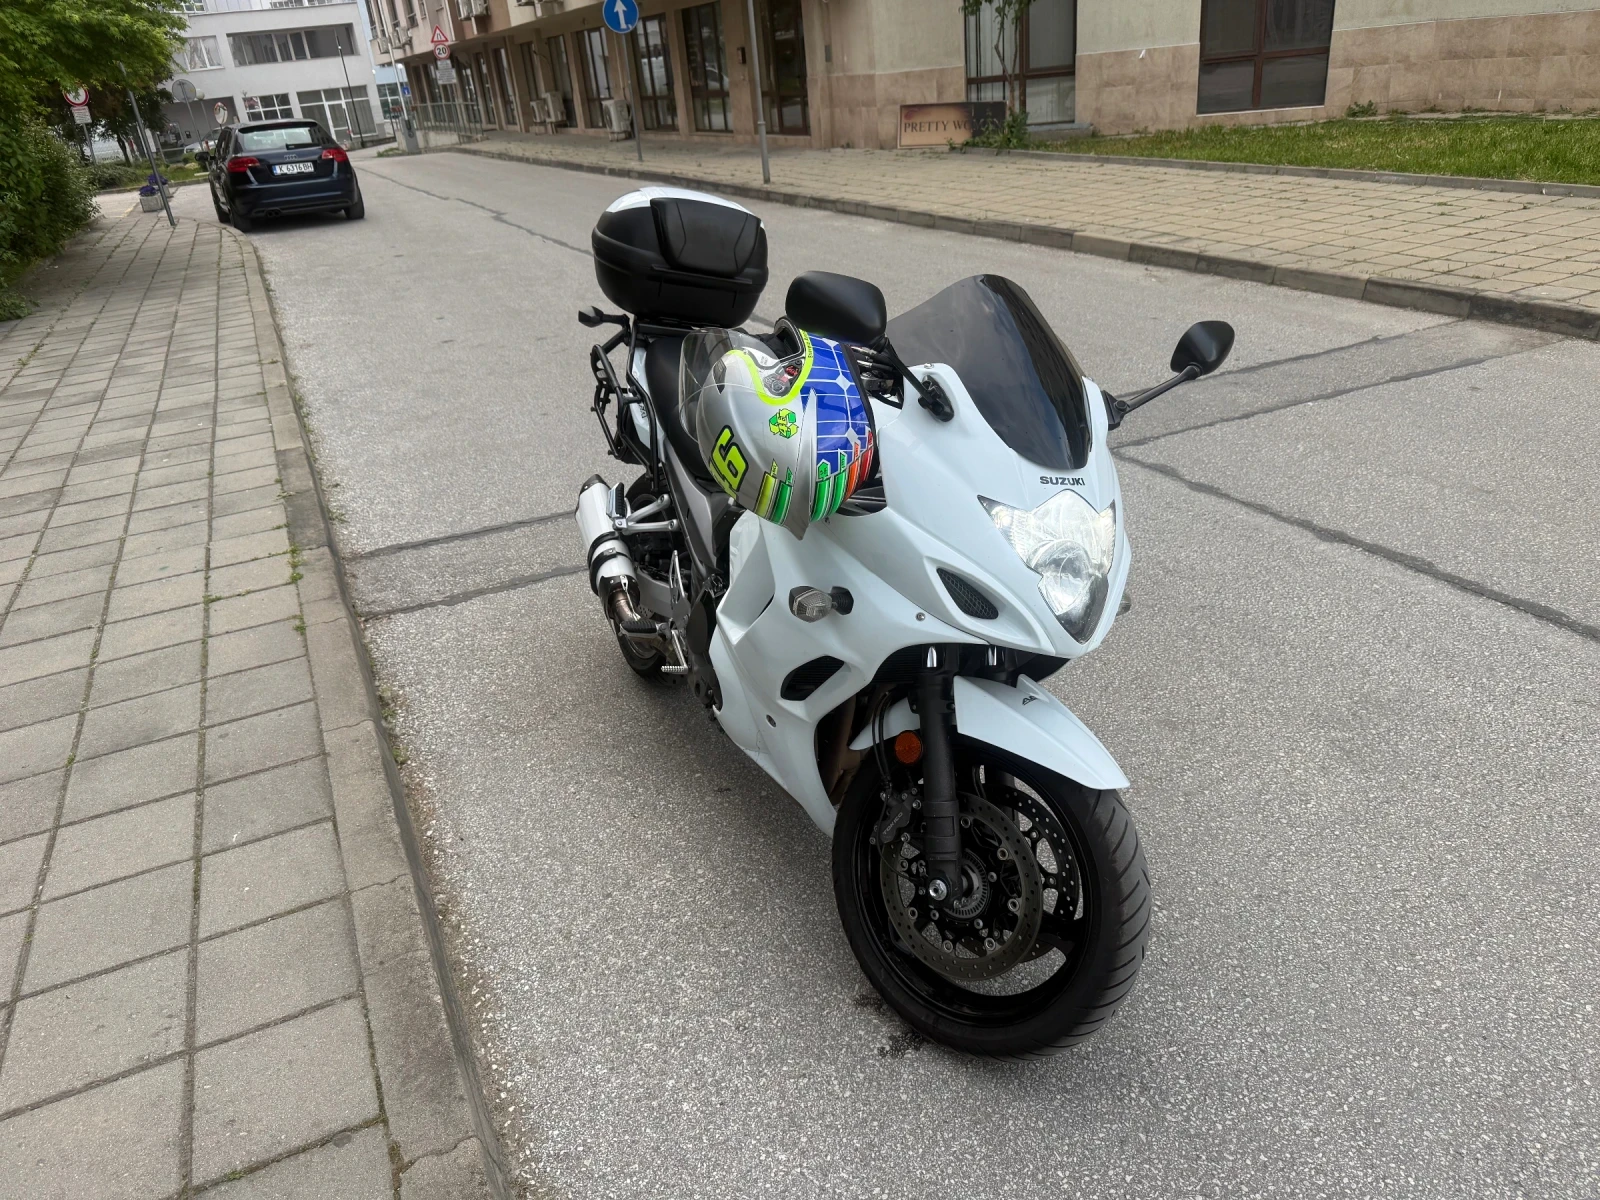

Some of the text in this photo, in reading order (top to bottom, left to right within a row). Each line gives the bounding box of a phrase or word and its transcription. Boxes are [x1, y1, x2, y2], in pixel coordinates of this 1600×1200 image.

[437, 46, 447, 55] 20
[904, 120, 949, 133] PRETTY
[1039, 475, 1086, 486] SUZUKI
